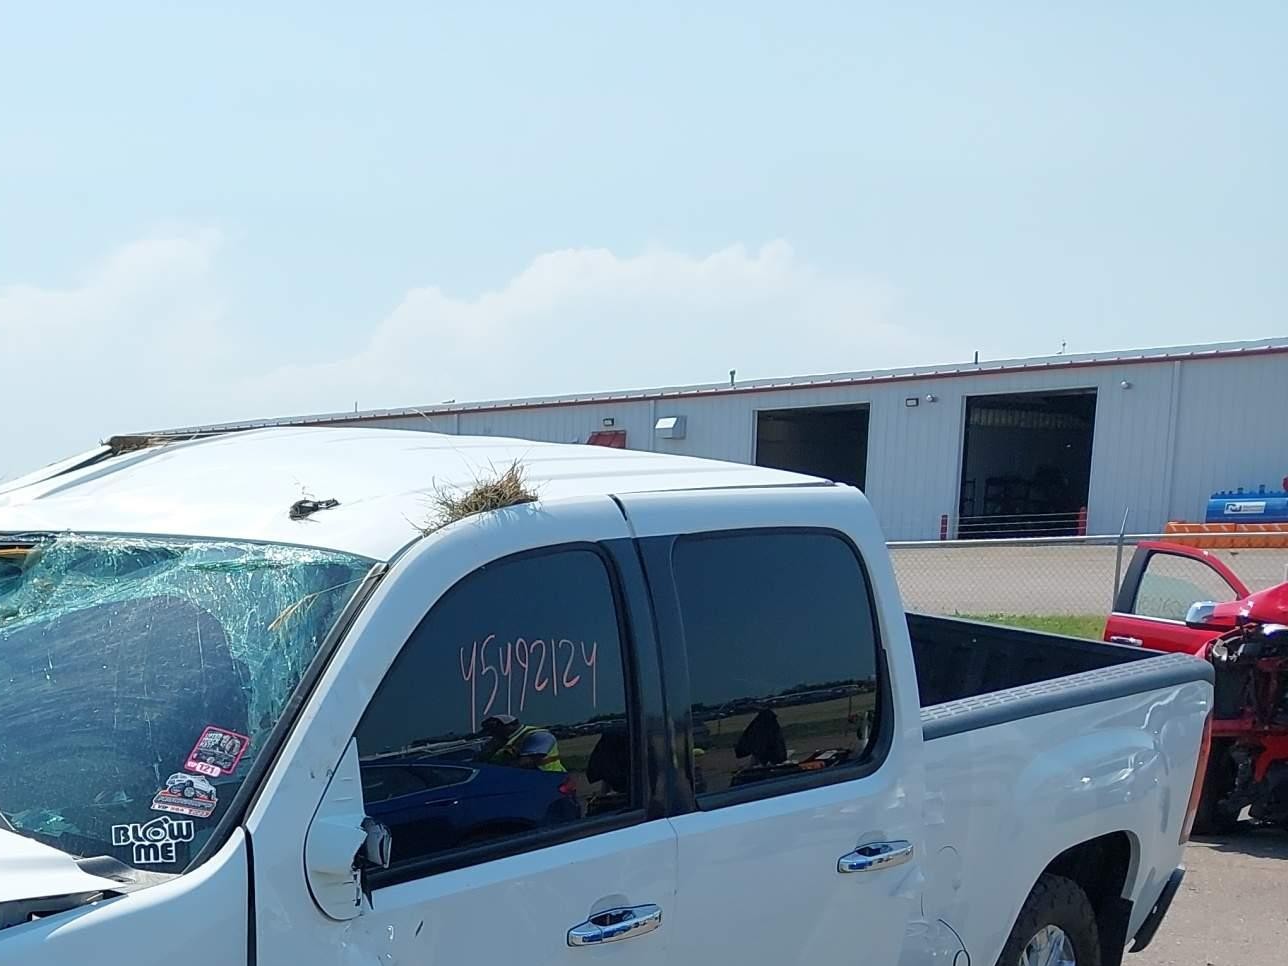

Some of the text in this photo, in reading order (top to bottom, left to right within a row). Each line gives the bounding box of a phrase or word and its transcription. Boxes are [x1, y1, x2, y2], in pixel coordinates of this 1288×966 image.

[460, 634, 597, 734] 45492124
[112, 816, 194, 846] BLOW
[133, 842, 177, 864] ME
